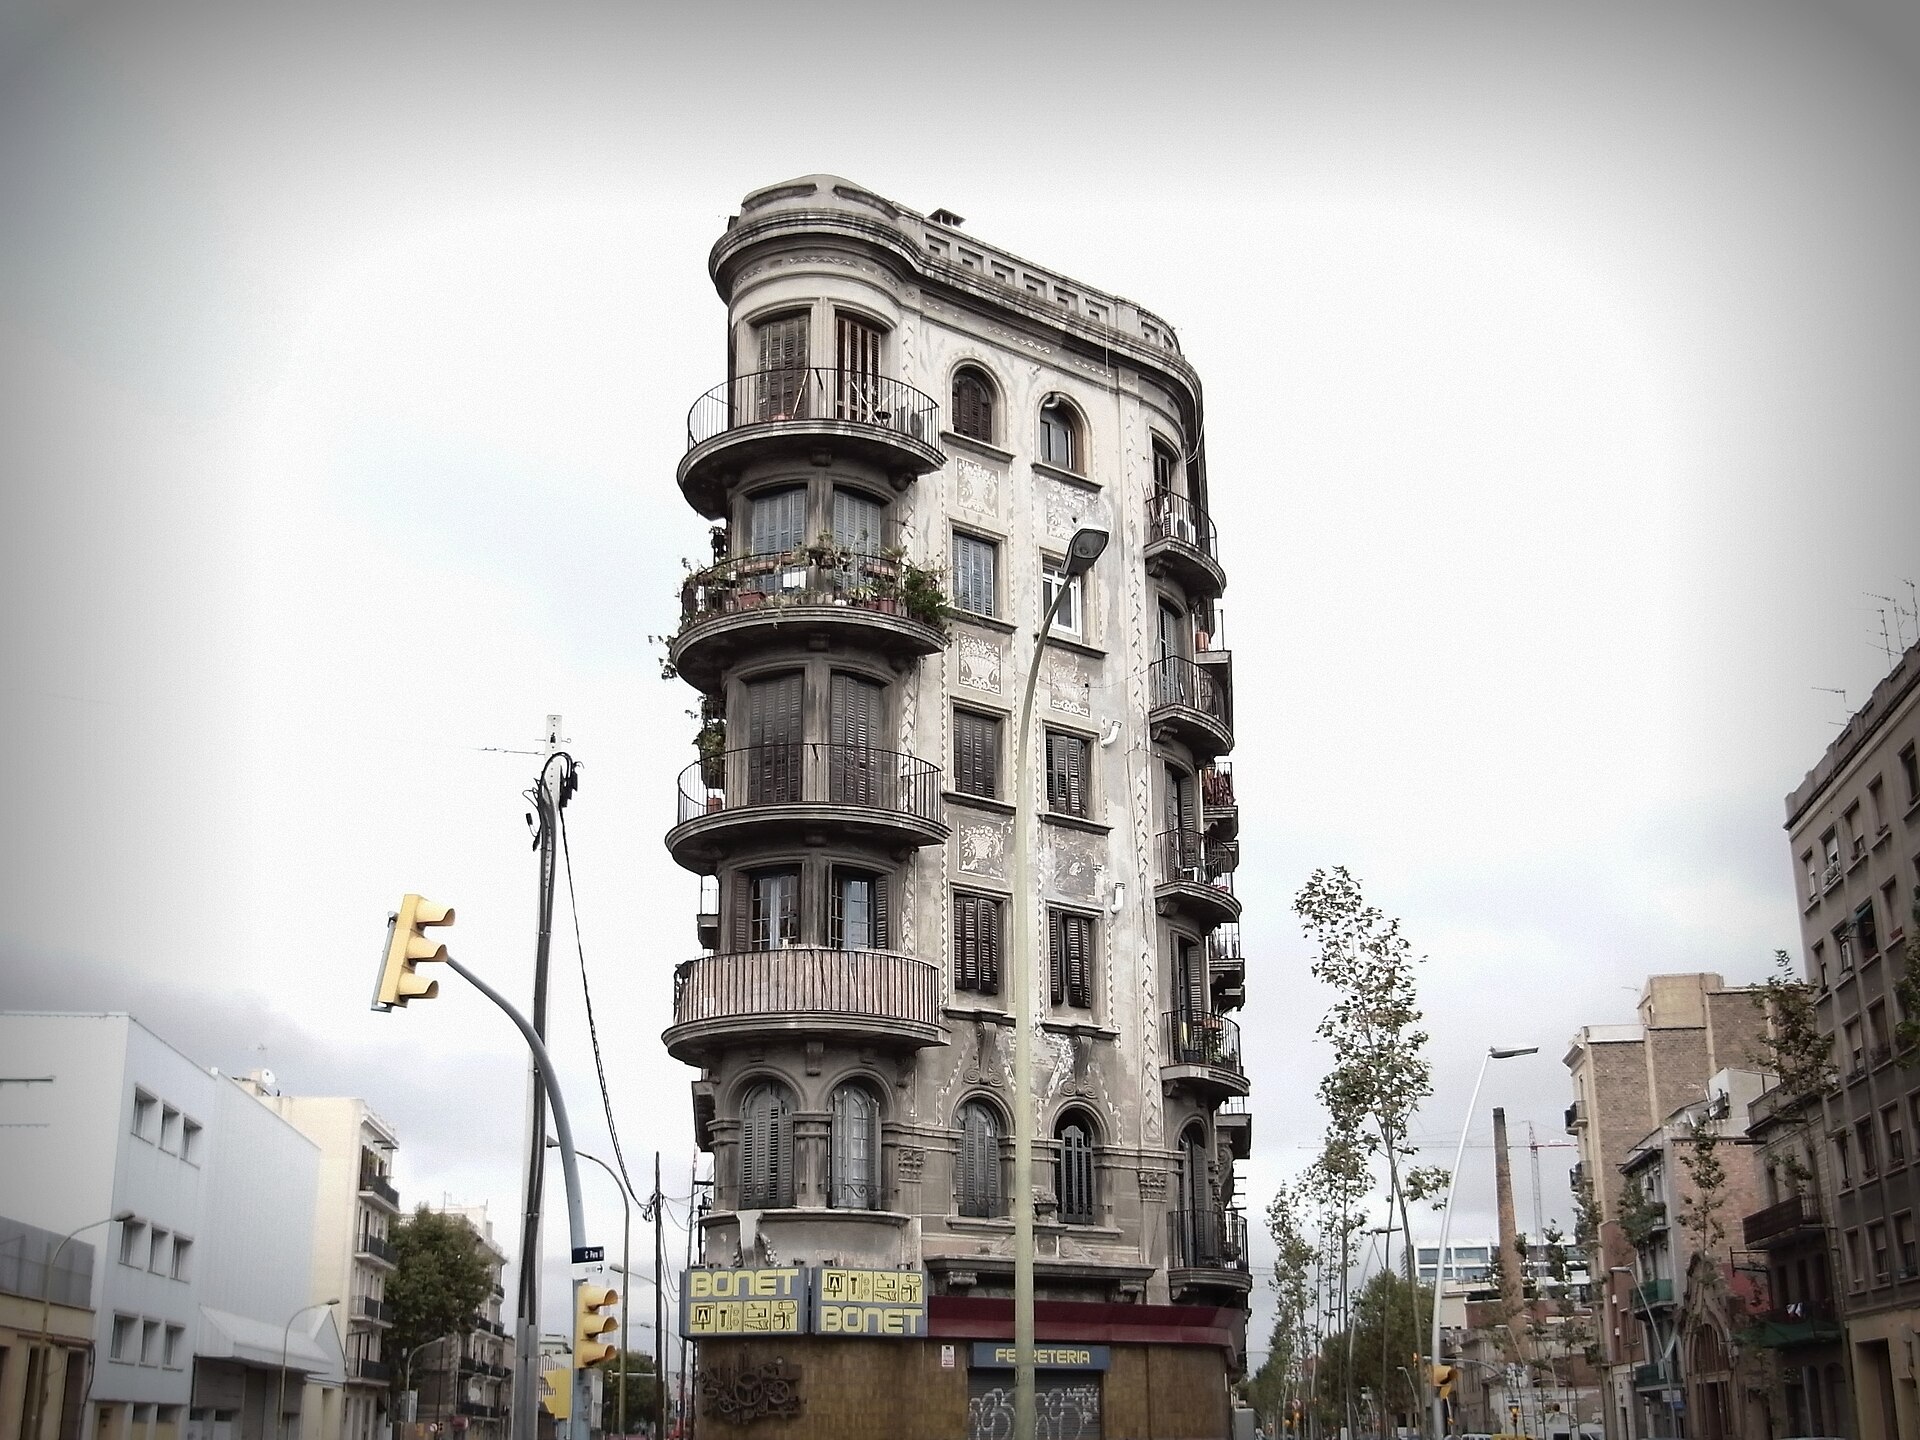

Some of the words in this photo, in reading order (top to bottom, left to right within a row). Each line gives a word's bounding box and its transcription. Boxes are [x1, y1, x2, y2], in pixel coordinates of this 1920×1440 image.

[691, 1269, 799, 1297] BONET
[821, 1306, 923, 1334] BONET
[995, 1348, 1090, 1364] FEETERIA
